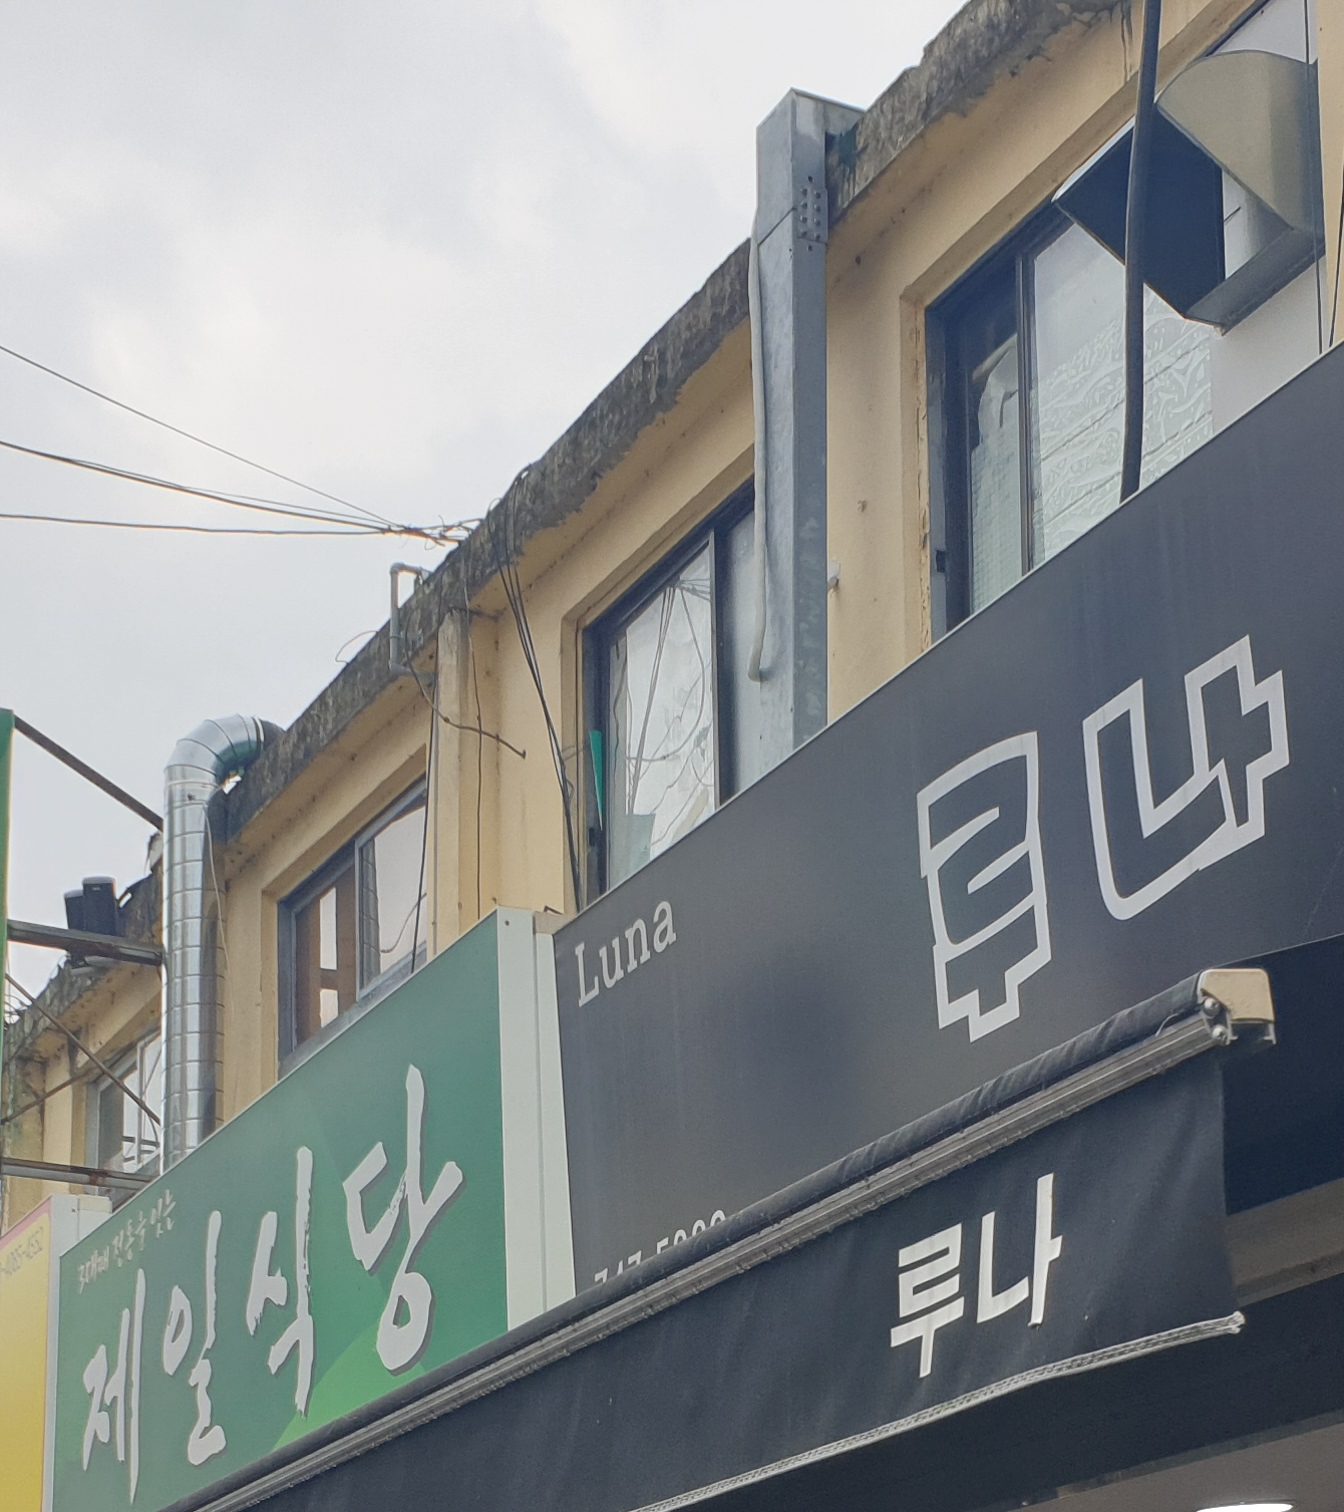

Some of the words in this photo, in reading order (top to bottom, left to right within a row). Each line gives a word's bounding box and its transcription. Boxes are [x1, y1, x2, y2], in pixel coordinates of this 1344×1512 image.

[574, 900, 678, 1007] Luna
[916, 634, 1290, 1043] 루나
[82, 1063, 464, 1506] 제일식당
[890, 1173, 1064, 1379] 루나
